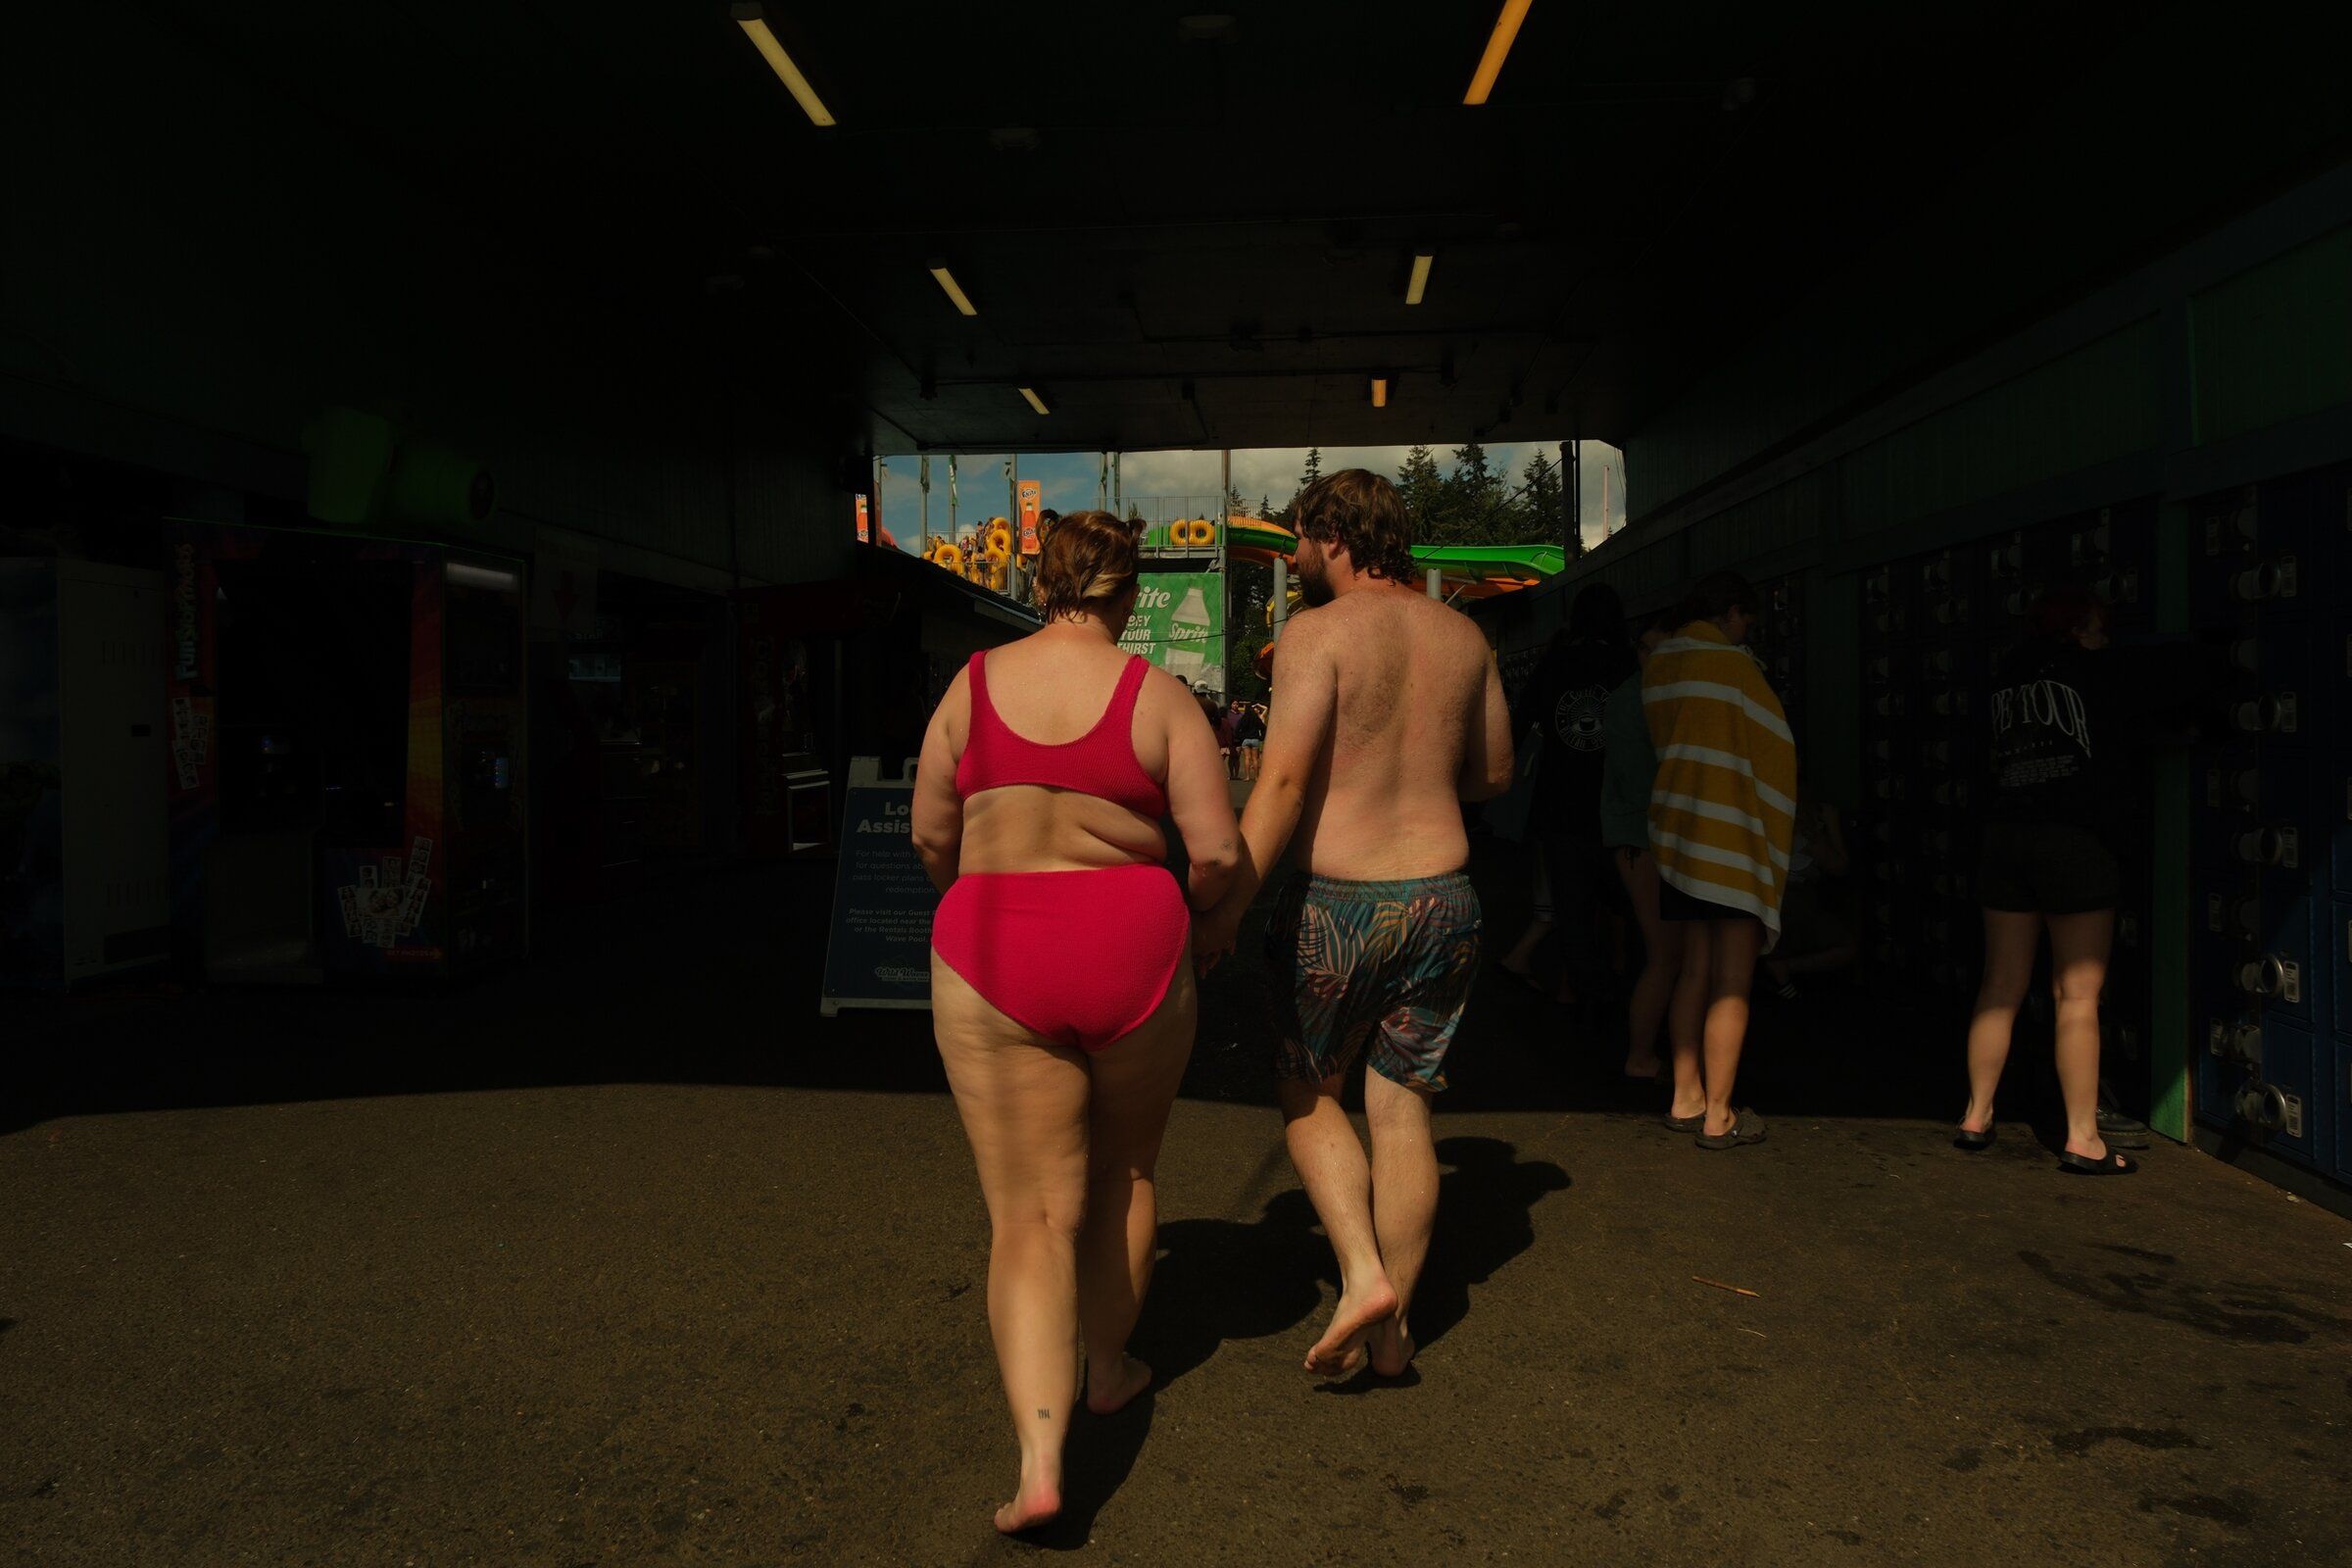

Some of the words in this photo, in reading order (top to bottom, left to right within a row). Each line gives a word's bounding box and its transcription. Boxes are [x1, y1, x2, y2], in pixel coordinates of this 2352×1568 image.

[1120, 629, 1152, 641] YOUR
[1117, 642, 1156, 655] THIRST
[2016, 679, 2091, 759] TOUR
[884, 801, 911, 816] Lo
[893, 849, 909, 858] with
[870, 861, 909, 871] questions
[849, 907, 873, 916] Please
[875, 907, 892, 916] visit
